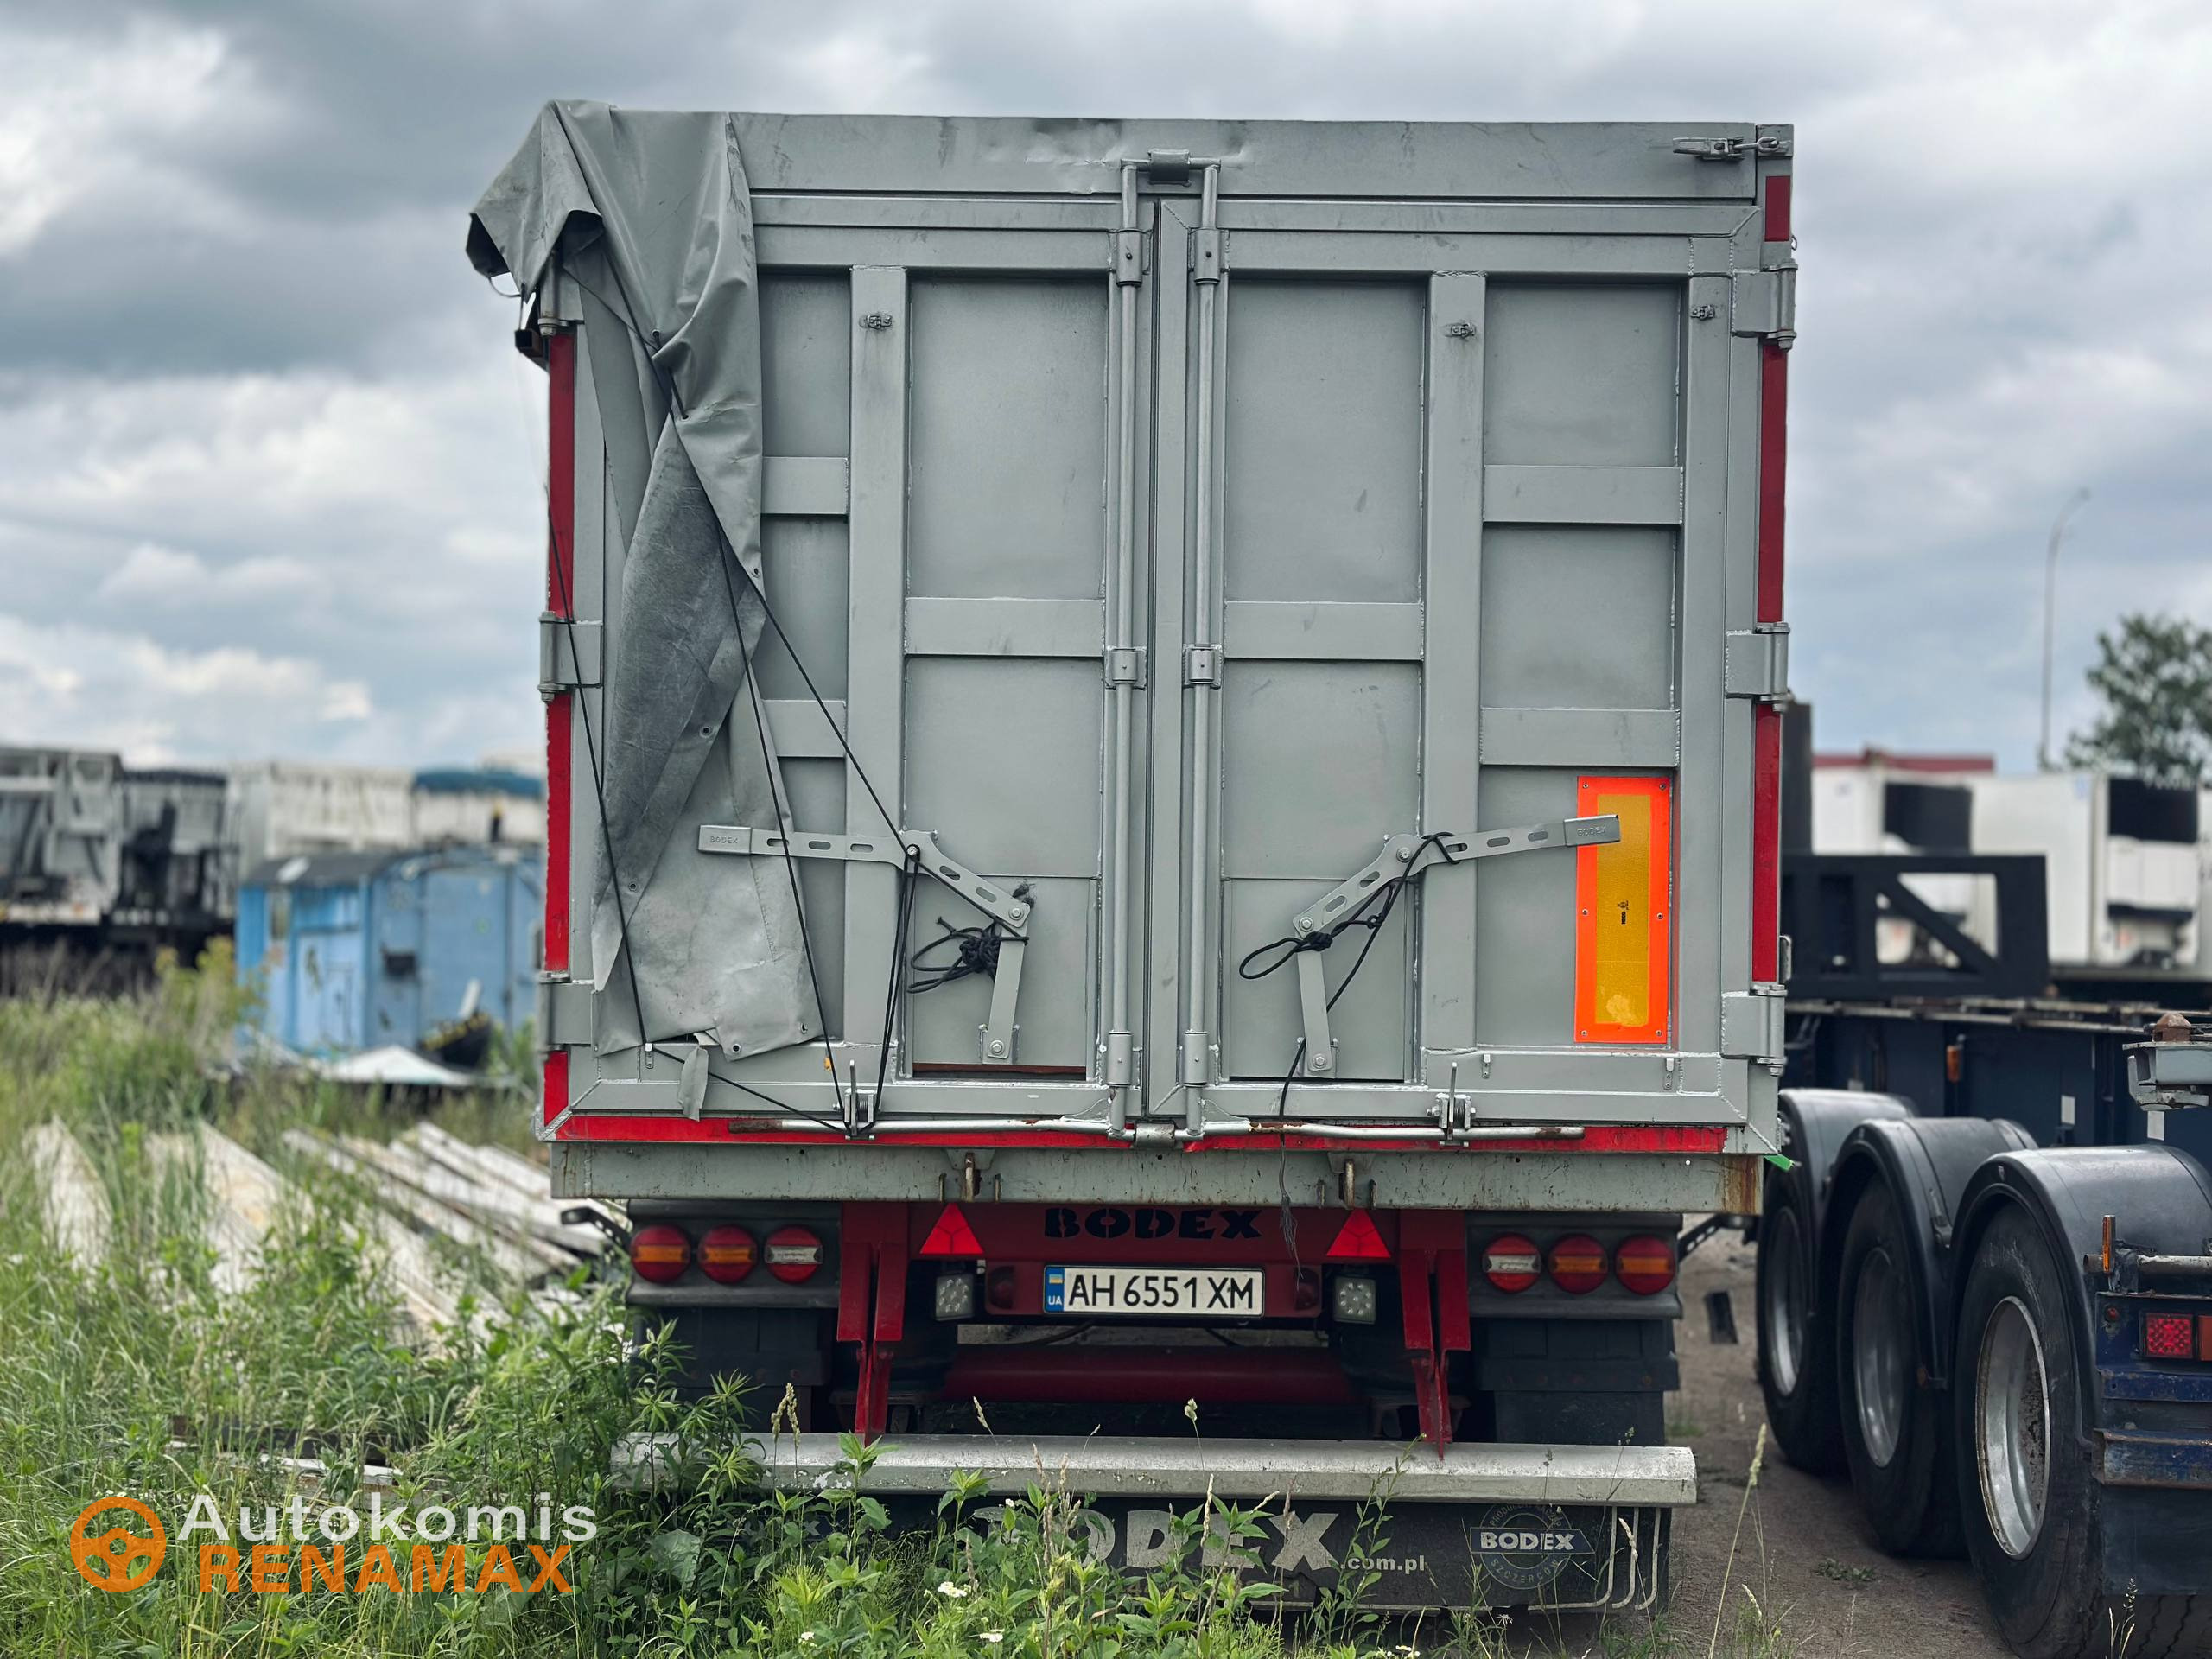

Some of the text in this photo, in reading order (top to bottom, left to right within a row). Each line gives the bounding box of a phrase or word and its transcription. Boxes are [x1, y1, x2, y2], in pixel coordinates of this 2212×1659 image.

[710, 836, 738, 844] BODEX
[1044, 1208, 1263, 1239] BODEX
[1047, 1295, 1063, 1306] UA
[1068, 1274, 1253, 1309] AH 6551 XM
[1480, 1531, 1575, 1551] BODEX
